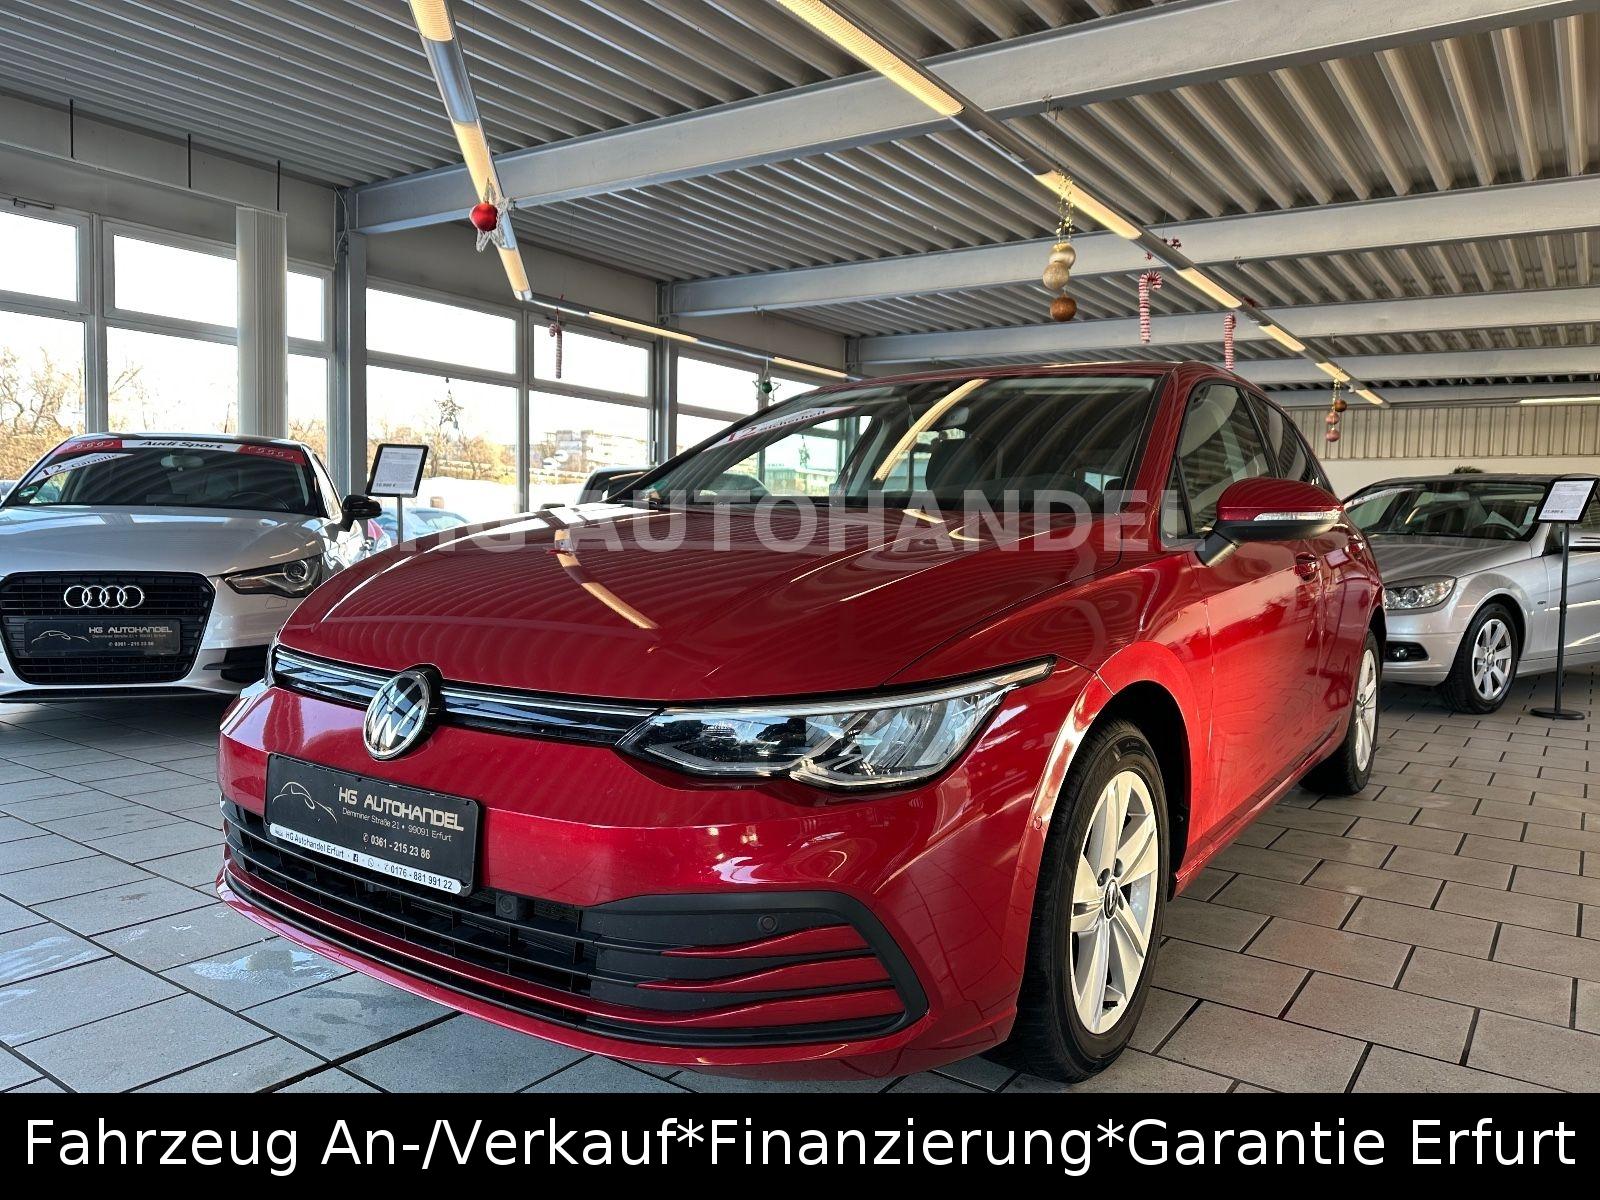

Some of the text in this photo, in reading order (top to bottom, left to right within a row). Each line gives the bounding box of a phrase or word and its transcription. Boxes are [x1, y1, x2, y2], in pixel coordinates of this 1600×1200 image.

[178, 441, 223, 449] Sport
[88, 626, 173, 634] HG AUTOHANDEL
[338, 786, 465, 832] HG AUTOHANDEL
[342, 807, 452, 843] Demminer Straße 21 99091 Erfurt
[370, 834, 388, 848] 0361
[394, 842, 409, 855] 215
[409, 845, 419, 857] 23
[420, 848, 431, 860] 86
[326, 845, 344, 859] Erfurt
[390, 864, 407, 878] 0176
[427, 874, 441, 887] 991
[443, 878, 453, 890] 22
